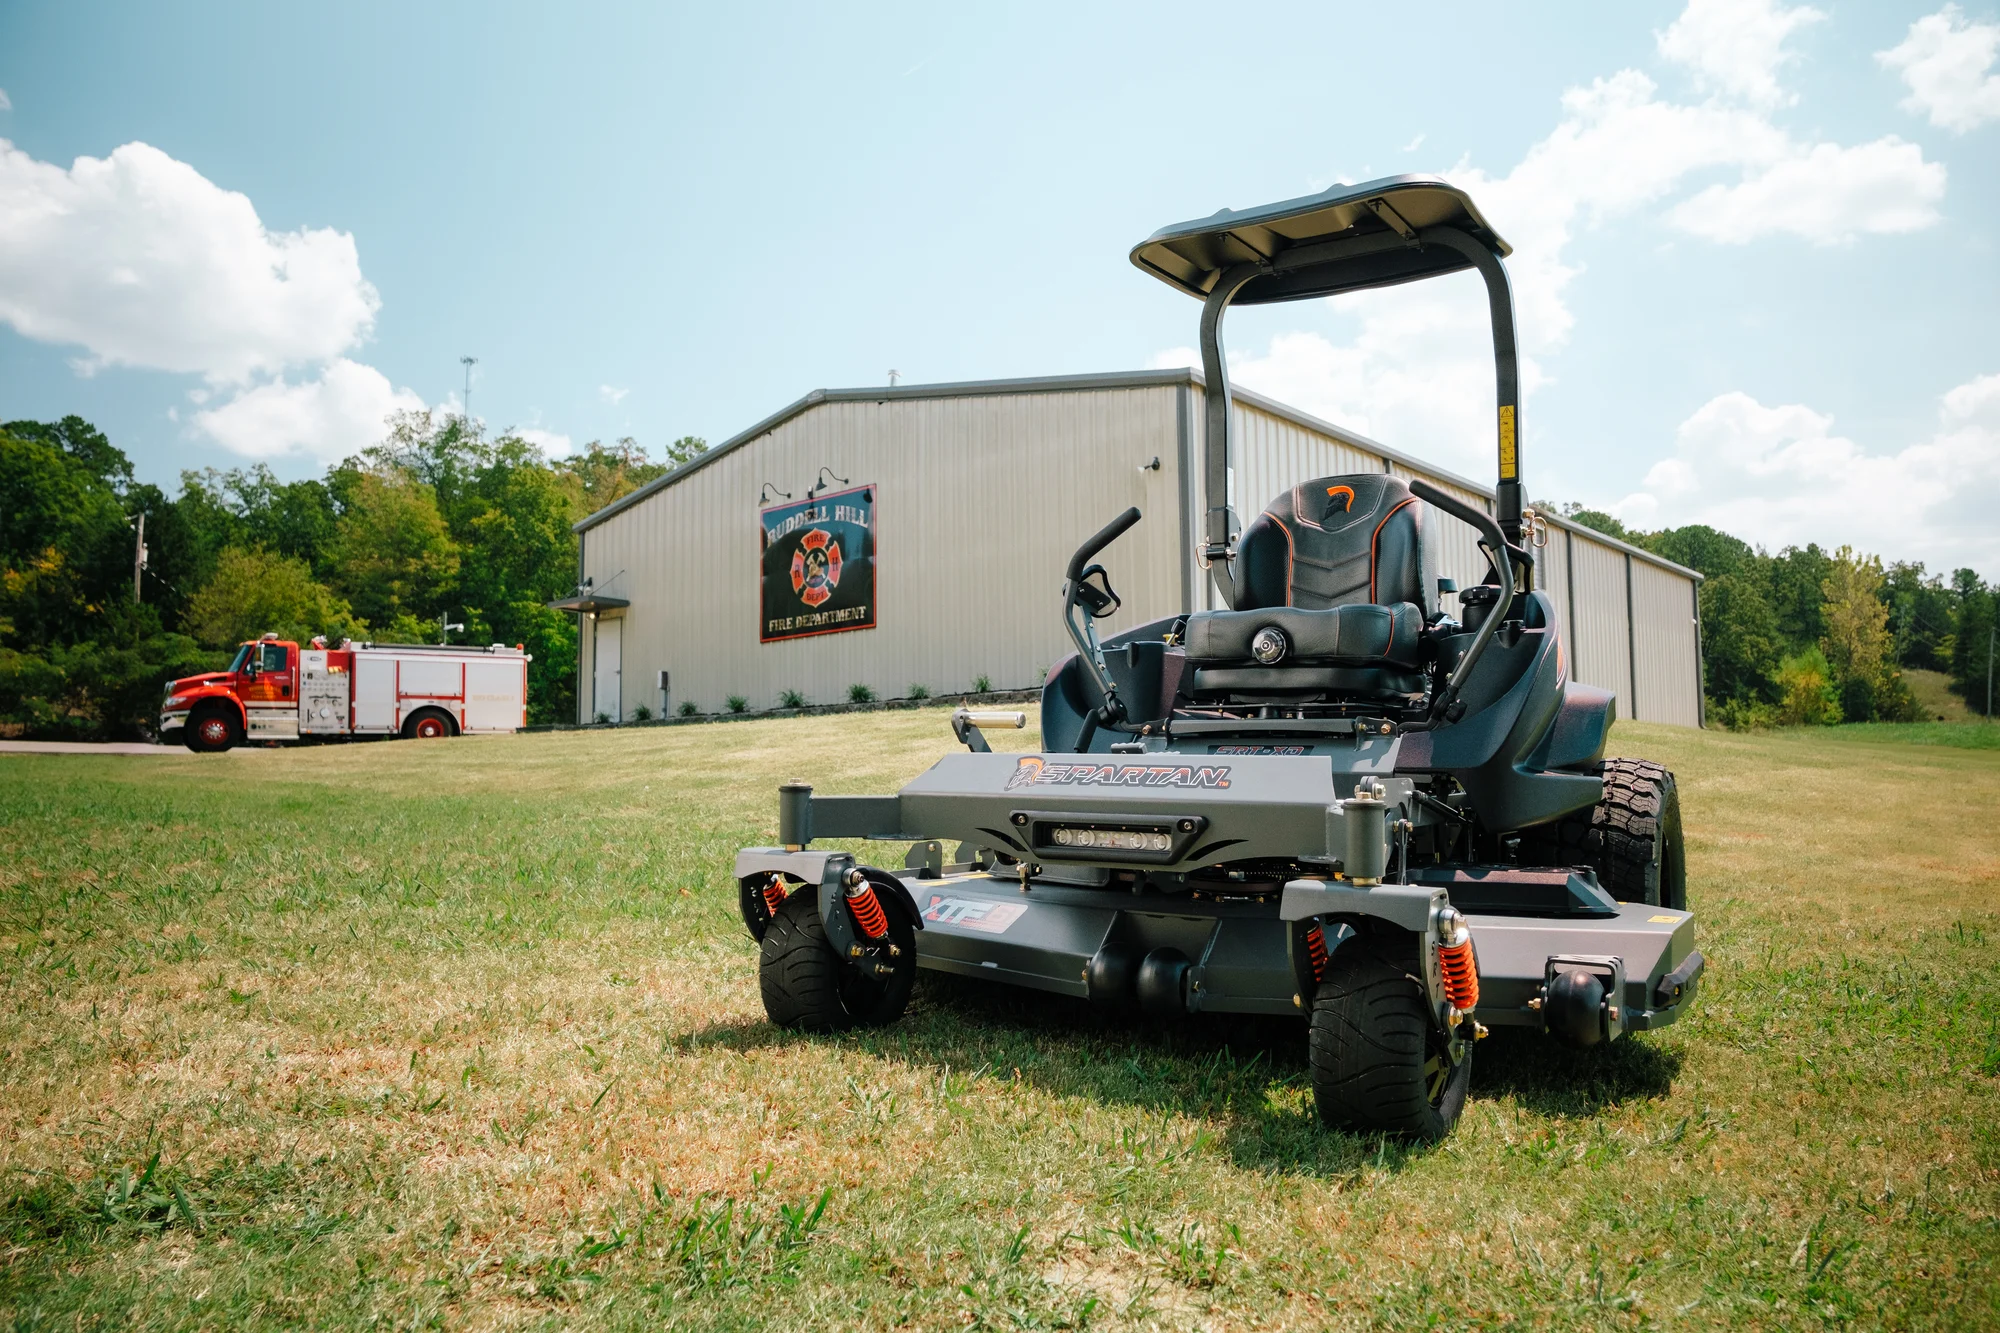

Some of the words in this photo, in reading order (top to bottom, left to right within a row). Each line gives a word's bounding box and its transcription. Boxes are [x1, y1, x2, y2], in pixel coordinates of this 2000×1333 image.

[767, 505, 830, 547] RUDDELL
[835, 504, 869, 529] HILL
[806, 533, 825, 545] FIRE
[794, 564, 800, 578] R
[832, 557, 839, 572] H
[806, 591, 825, 602] DEPT
[768, 617, 793, 632] FIRE
[795, 606, 867, 627] DEPARTMENT
[1035, 765, 1229, 786] SPARTAN
